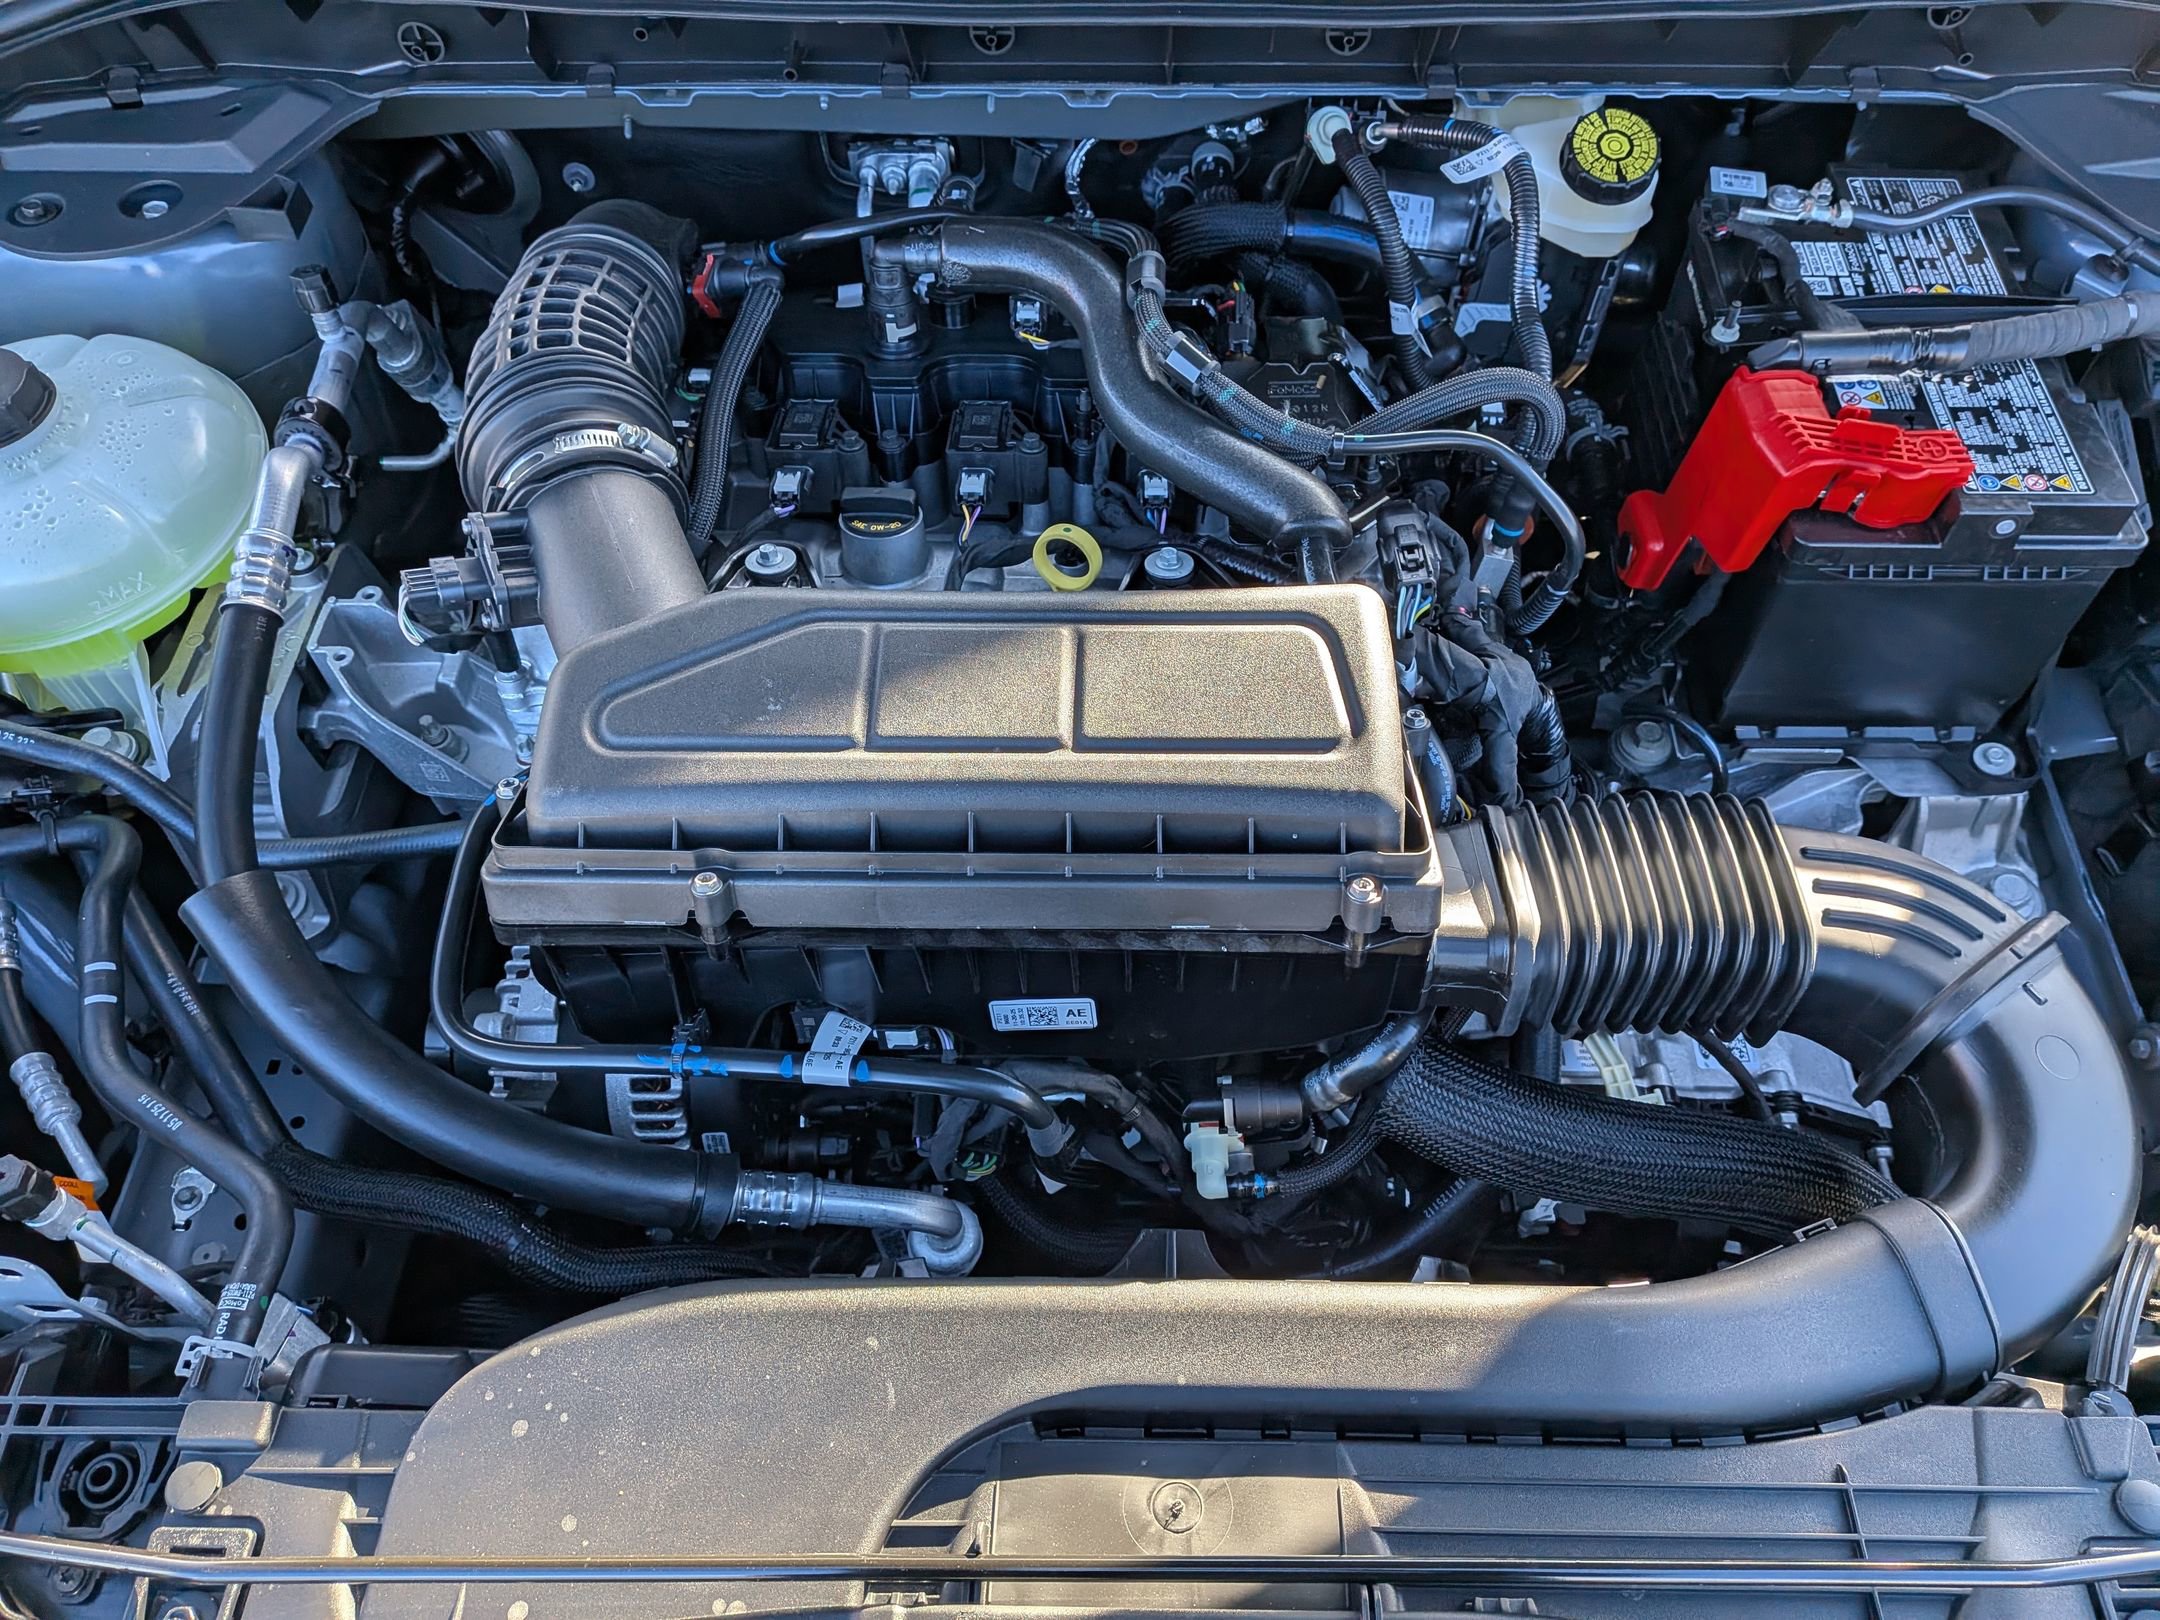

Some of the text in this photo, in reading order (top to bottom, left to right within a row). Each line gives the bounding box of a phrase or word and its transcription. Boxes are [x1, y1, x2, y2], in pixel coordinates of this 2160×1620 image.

[2072, 471, 2083, 481] NOT
[2077, 481, 2089, 490] DO
[851, 520, 902, 531] SAE 0W-20
[1065, 1008, 1088, 1018] AE
[216, 1312, 231, 1335] RAD
